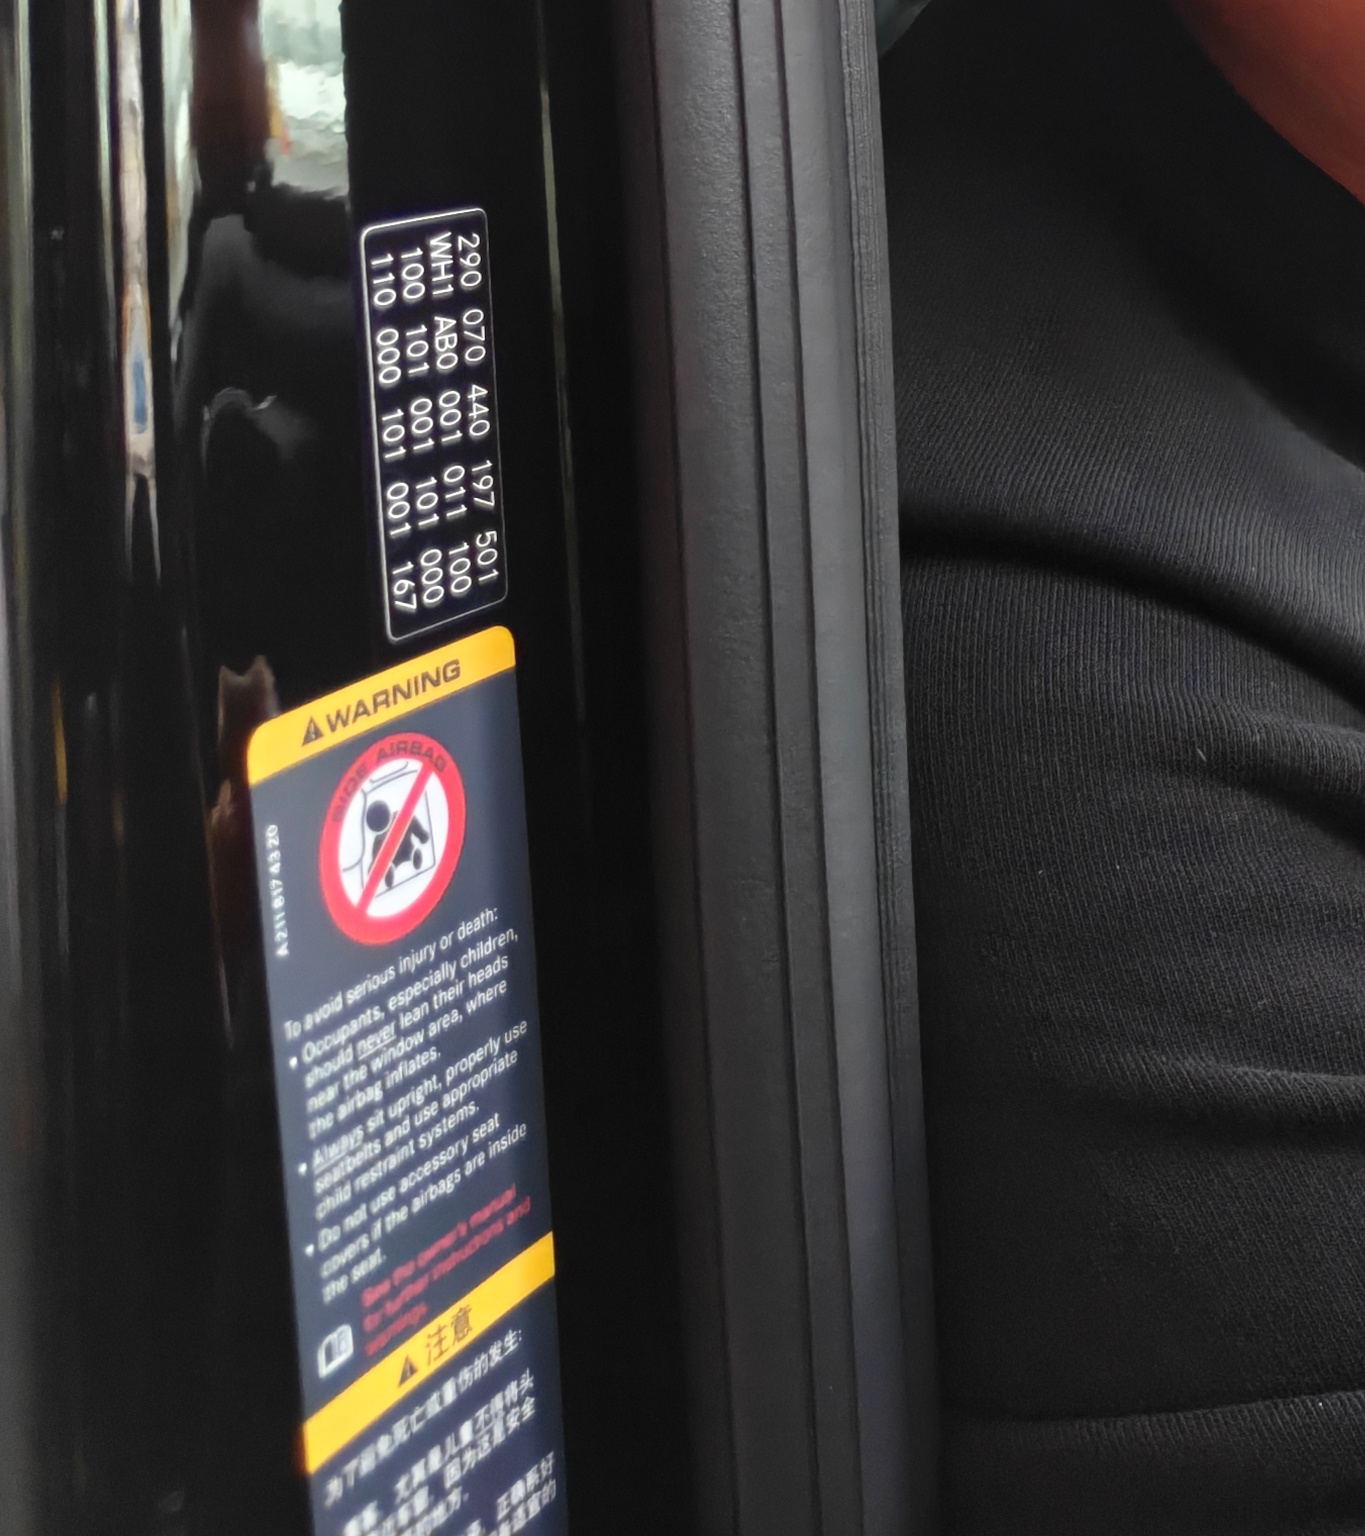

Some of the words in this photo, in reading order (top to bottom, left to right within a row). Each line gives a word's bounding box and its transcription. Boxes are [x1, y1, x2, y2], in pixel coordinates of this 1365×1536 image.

[371, 252, 396, 308] 110
[400, 246, 425, 302] 100
[429, 232, 454, 297] WH1
[457, 231, 482, 289] 290
[375, 326, 400, 385] 000
[405, 323, 429, 377] 101
[462, 306, 485, 365] 070
[381, 407, 405, 461] 101
[410, 396, 434, 453] 001
[438, 389, 461, 446] 001
[467, 381, 490, 438] 440
[385, 480, 410, 538] 001
[415, 475, 438, 528] 101
[443, 463, 466, 519] 011
[471, 459, 494, 511] 197
[419, 546, 444, 605] 000
[447, 541, 471, 595] 100
[475, 529, 498, 584] 501
[391, 559, 416, 614] 167
[324, 658, 461, 734] WARNING
[376, 739, 448, 773] AIRBAG
[284, 1015, 301, 1042] To
[303, 991, 342, 1031] avoid
[345, 960, 395, 1006] serious
[398, 937, 436, 979] injury
[439, 931, 453, 952] or
[457, 902, 498, 941] death:
[301, 999, 385, 1068] Occupants,
[387, 957, 456, 1016] especially
[459, 920, 517, 973] children,
[304, 1042, 353, 1089] should
[357, 1020, 396, 1057] never
[399, 997, 428, 1031] lean
[432, 976, 464, 1010] their
[468, 950, 508, 989] heads
[306, 1080, 339, 1114] near
[342, 1060, 367, 1091] the
[370, 1024, 424, 1073] window
[428, 1004, 462, 1040] area,
[466, 975, 507, 1014] where
[308, 1107, 334, 1139] the
[336, 1076, 383, 1126] airbag
[385, 1041, 440, 1089] inflates.
[312, 1120, 363, 1171] Always
[366, 1106, 384, 1132] sit
[387, 1070, 441, 1122] upright,
[445, 1032, 500, 1085] properly
[504, 1018, 527, 1044] use
[313, 1135, 381, 1195] seatbelts
[383, 1115, 410, 1147] and
[414, 1100, 438, 1127] use
[442, 1046, 517, 1113] appropriate
[315, 1180, 352, 1221] child
[353, 1137, 414, 1195] restraint
[418, 1096, 479, 1153] systems.
[317, 1219, 340, 1252] Do
[343, 1201, 367, 1232] not
[370, 1184, 396, 1213] use
[398, 1133, 469, 1198] accessory
[471, 1111, 499, 1144] seat
[320, 1230, 369, 1280] covers
[371, 1218, 382, 1243] if
[384, 1201, 408, 1233] the
[411, 1164, 461, 1218] airbags
[464, 1151, 485, 1176] are
[488, 1117, 526, 1159] inside
[322, 1271, 348, 1306] the
[350, 1243, 386, 1283] seat.
[425, 1299, 473, 1367] 注意
